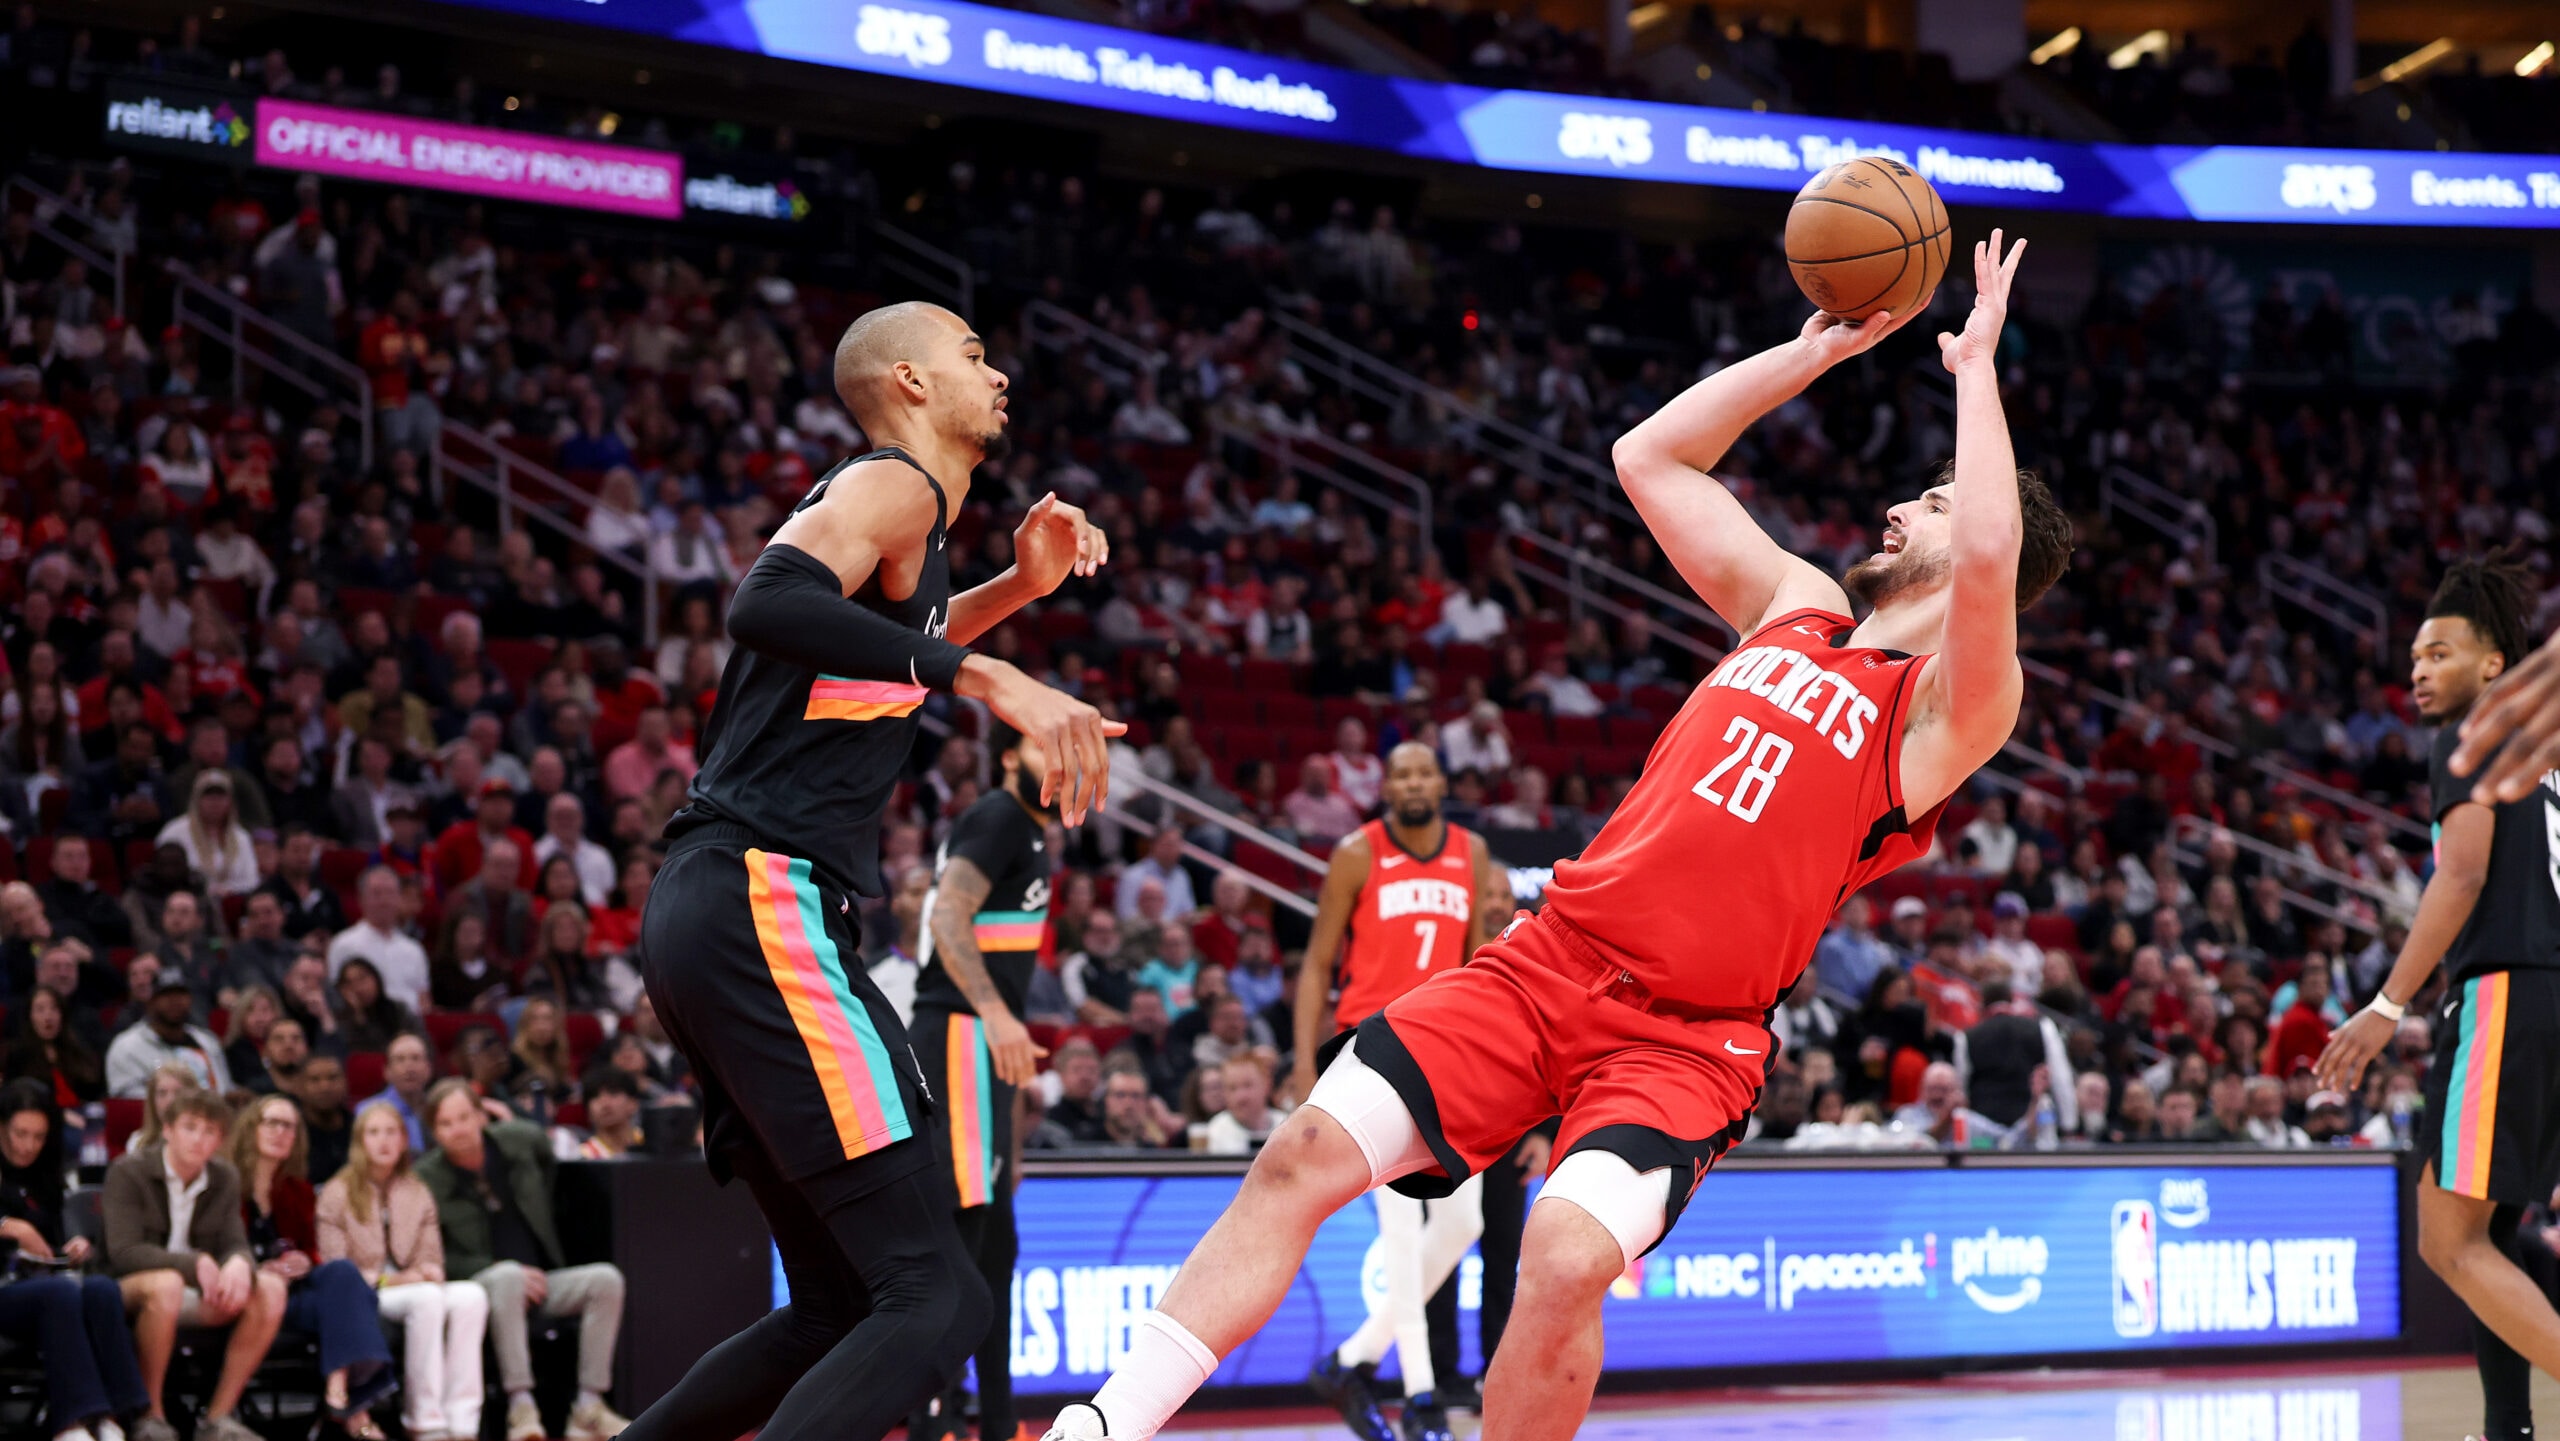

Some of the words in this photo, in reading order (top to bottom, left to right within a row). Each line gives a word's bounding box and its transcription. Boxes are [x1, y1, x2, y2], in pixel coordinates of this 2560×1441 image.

[855, 4, 952, 68] axs
[984, 28, 1097, 83] Events.
[1096, 46, 1212, 102] Tickets.
[1212, 66, 1337, 122] Rockets.
[108, 97, 213, 143] reliant
[1557, 112, 1654, 167] axs
[267, 117, 407, 168] OFFICIAL
[411, 135, 528, 181] ENERGY
[529, 155, 672, 200] PROVIDER
[1686, 125, 1799, 171] Events.
[1917, 144, 2064, 193] Moments.
[686, 174, 778, 218] reliant
[2281, 163, 2377, 215] axs
[2411, 170, 2528, 208] Events.
[1708, 646, 1880, 760] ROCKETS
[1692, 715, 1795, 824] 28
[1377, 877, 1470, 922] ROCKETS
[1414, 919, 1438, 971] 7
[1674, 1252, 1761, 1298] NBC
[1779, 1236, 1927, 1311] peacock
[1950, 1226, 2049, 1286] prime
[2159, 1238, 2274, 1332] RIVALS
[2271, 1237, 2359, 1328] WEEK
